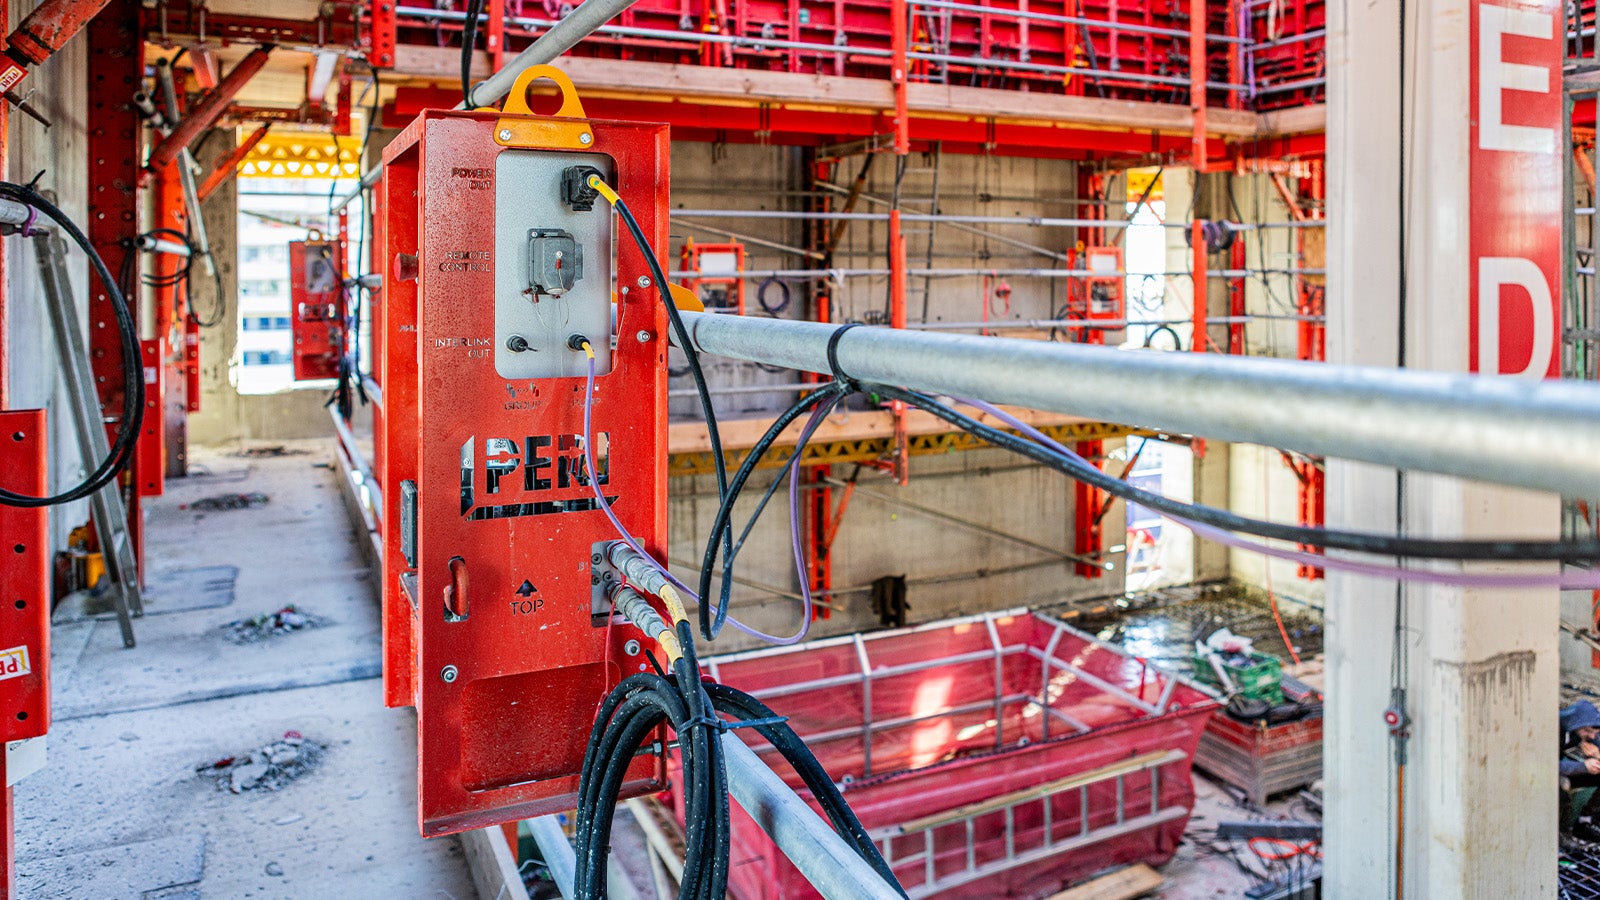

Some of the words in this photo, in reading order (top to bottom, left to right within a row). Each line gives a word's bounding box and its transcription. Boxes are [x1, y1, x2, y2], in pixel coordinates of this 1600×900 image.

[450, 167, 492, 179] POWER
[469, 180, 491, 190] OUT
[445, 251, 491, 261] REMOTE
[438, 261, 491, 273] CONTROL
[434, 338, 491, 348] INTERLINK
[468, 348, 491, 359] OUT
[504, 400, 543, 411] GROUP
[510, 599, 544, 616] TOP
